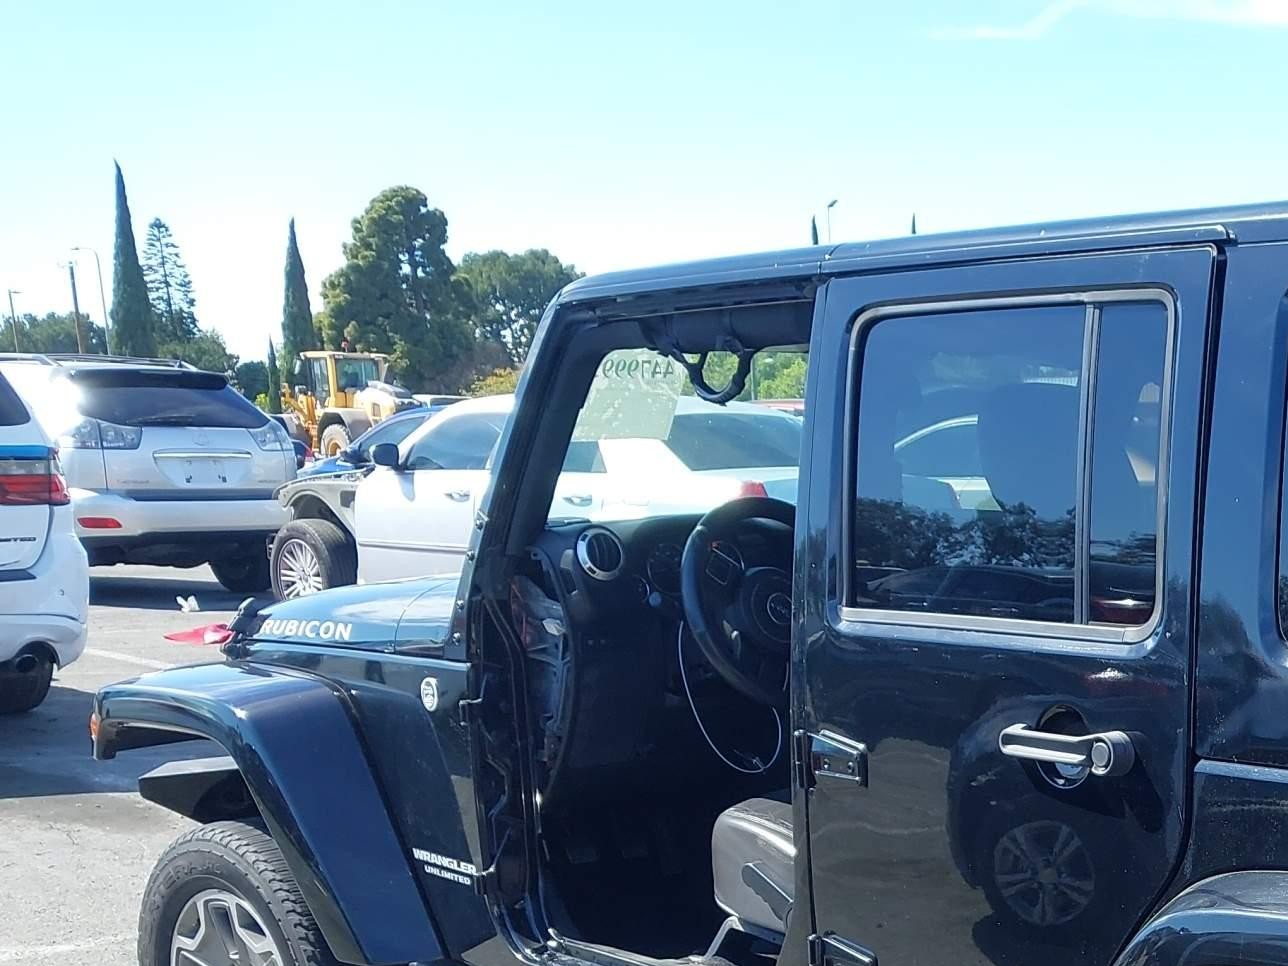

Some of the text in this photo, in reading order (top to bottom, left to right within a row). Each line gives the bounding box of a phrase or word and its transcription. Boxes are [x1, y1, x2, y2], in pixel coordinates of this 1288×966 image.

[259, 619, 353, 641] RUBICON
[411, 847, 478, 876] WRANGLER
[423, 864, 472, 886] UNLIMITED
